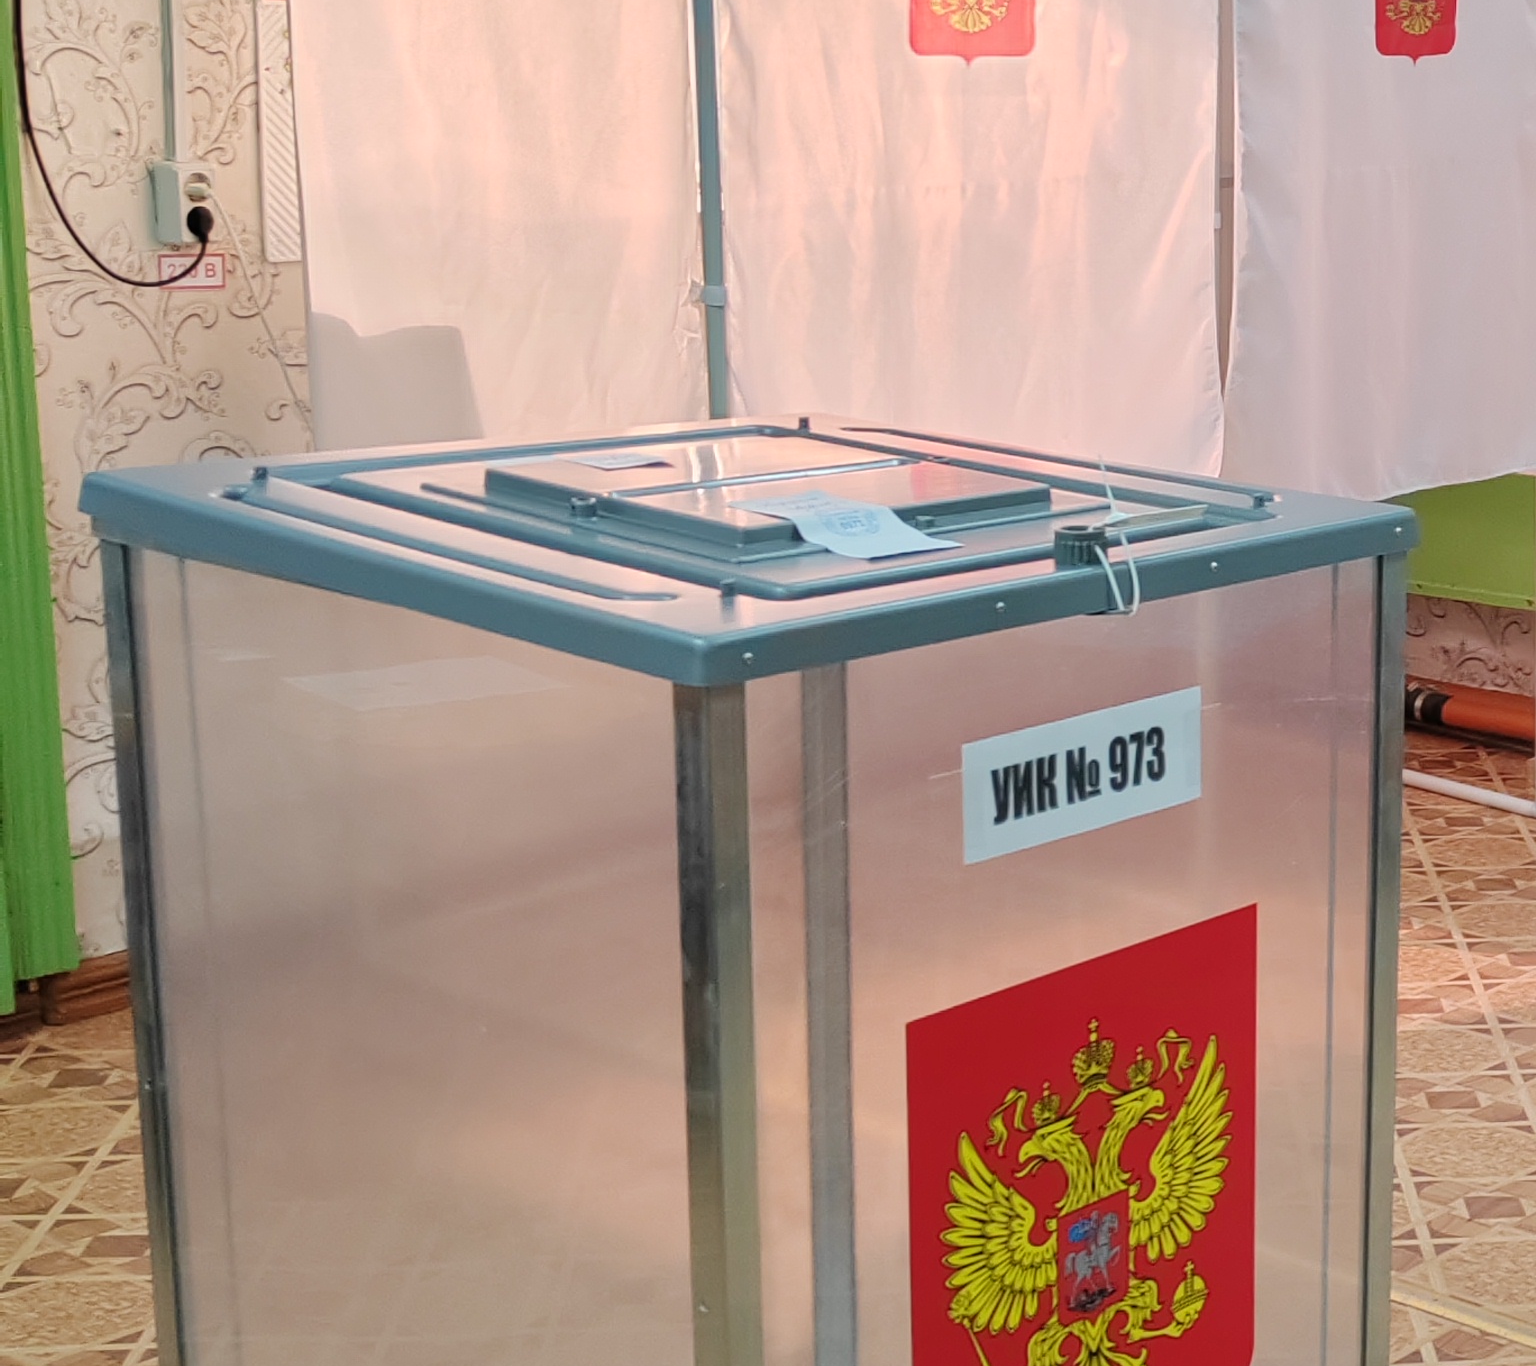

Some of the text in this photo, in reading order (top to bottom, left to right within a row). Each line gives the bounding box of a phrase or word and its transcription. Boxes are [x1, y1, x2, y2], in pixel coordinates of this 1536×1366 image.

[991, 726, 1166, 825] УИК № 973
